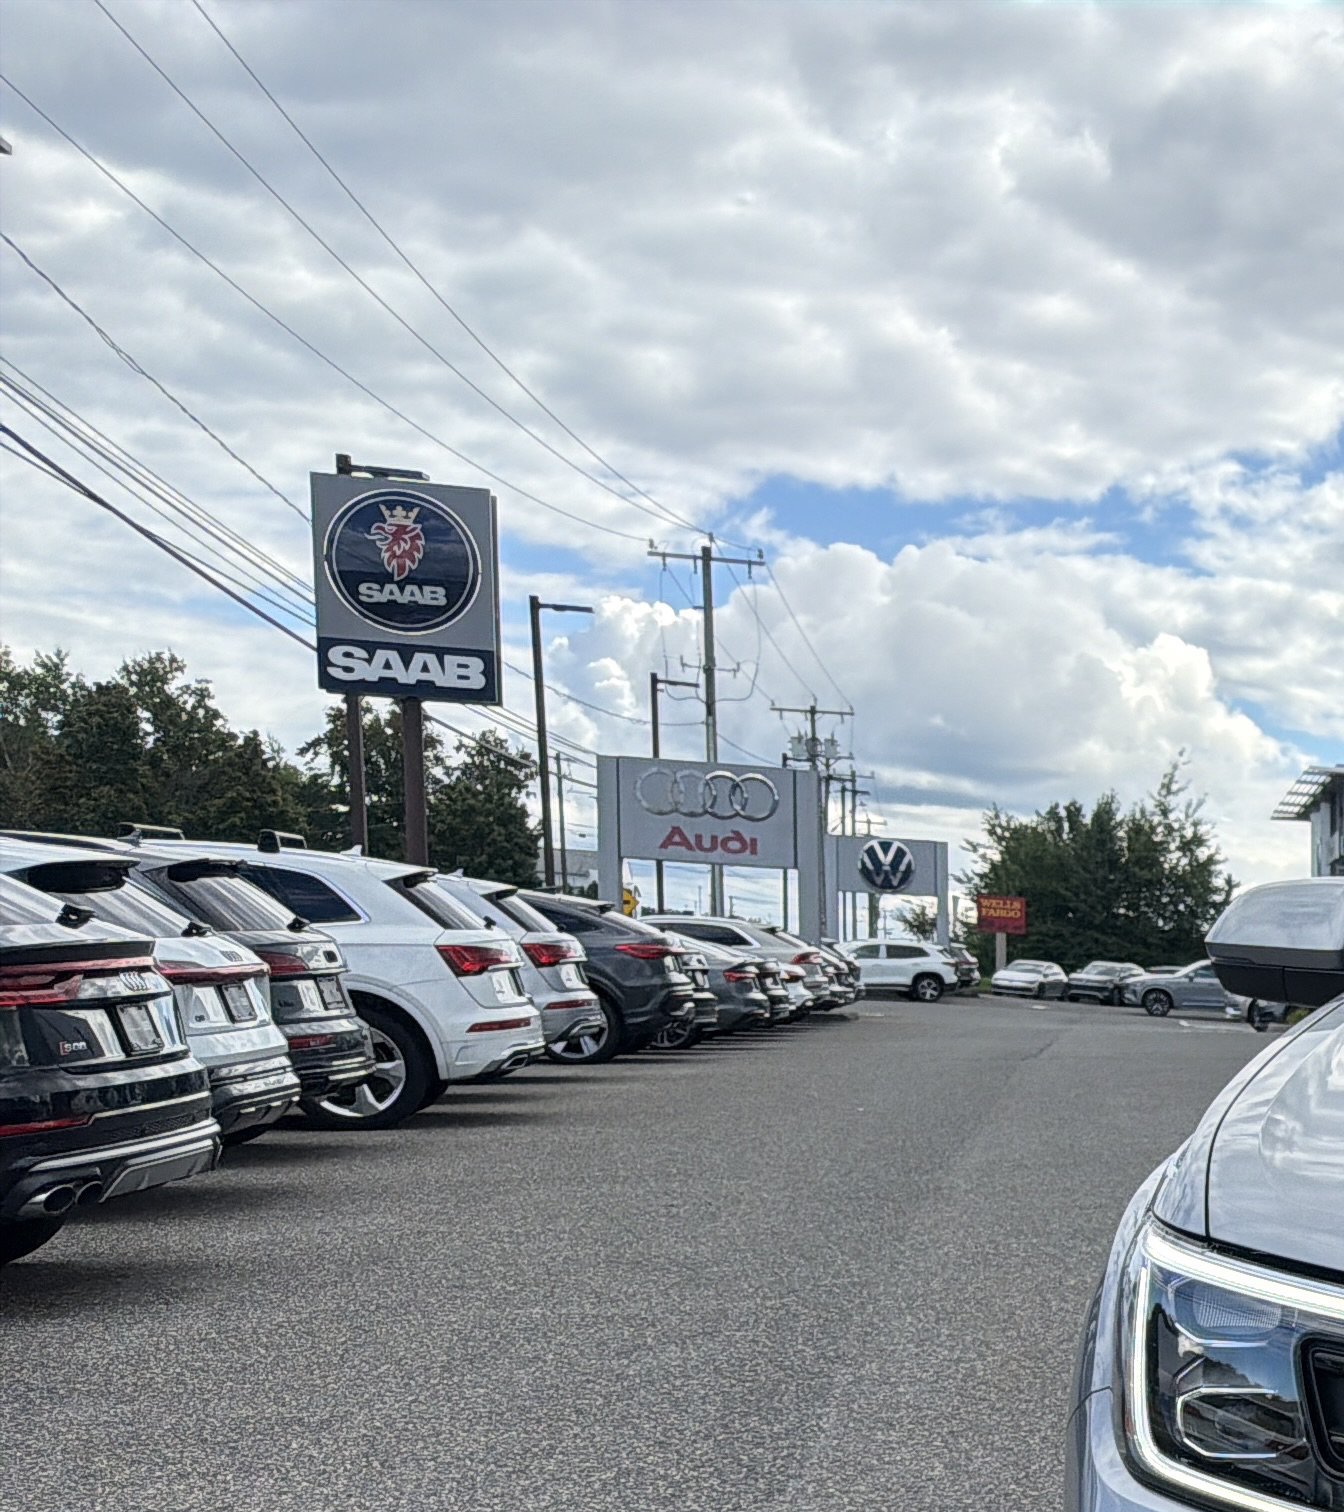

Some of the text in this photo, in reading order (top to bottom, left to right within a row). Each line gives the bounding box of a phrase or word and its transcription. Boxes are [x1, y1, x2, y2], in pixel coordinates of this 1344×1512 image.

[358, 582, 447, 606] SAAB
[327, 645, 486, 690] SAAB
[658, 825, 758, 856] Audi
[980, 899, 1021, 909] WELLS
